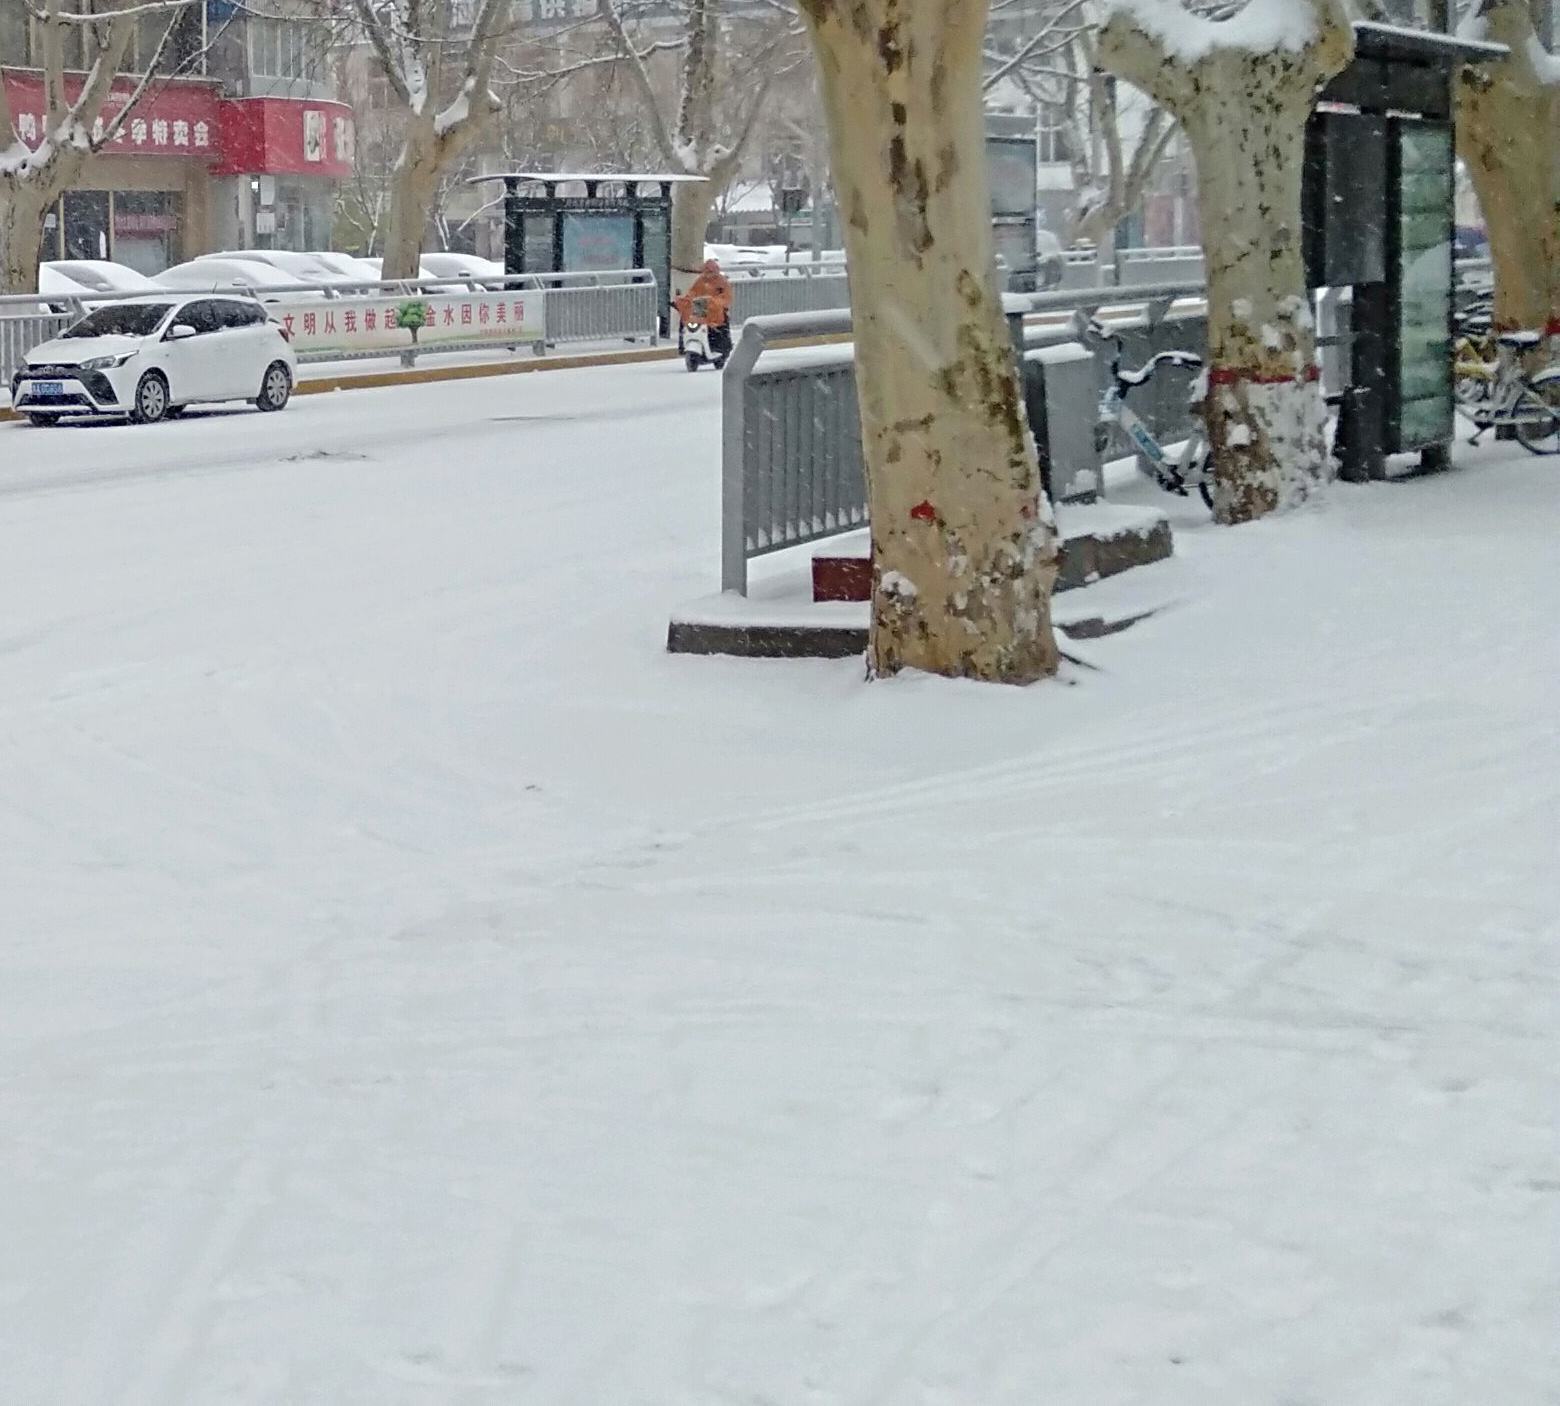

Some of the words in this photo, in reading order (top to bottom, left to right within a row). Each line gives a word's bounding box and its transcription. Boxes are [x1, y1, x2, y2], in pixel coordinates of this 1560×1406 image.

[282, 307, 399, 338] 文明从我做起
[424, 300, 525, 328] 金水因你美丽
